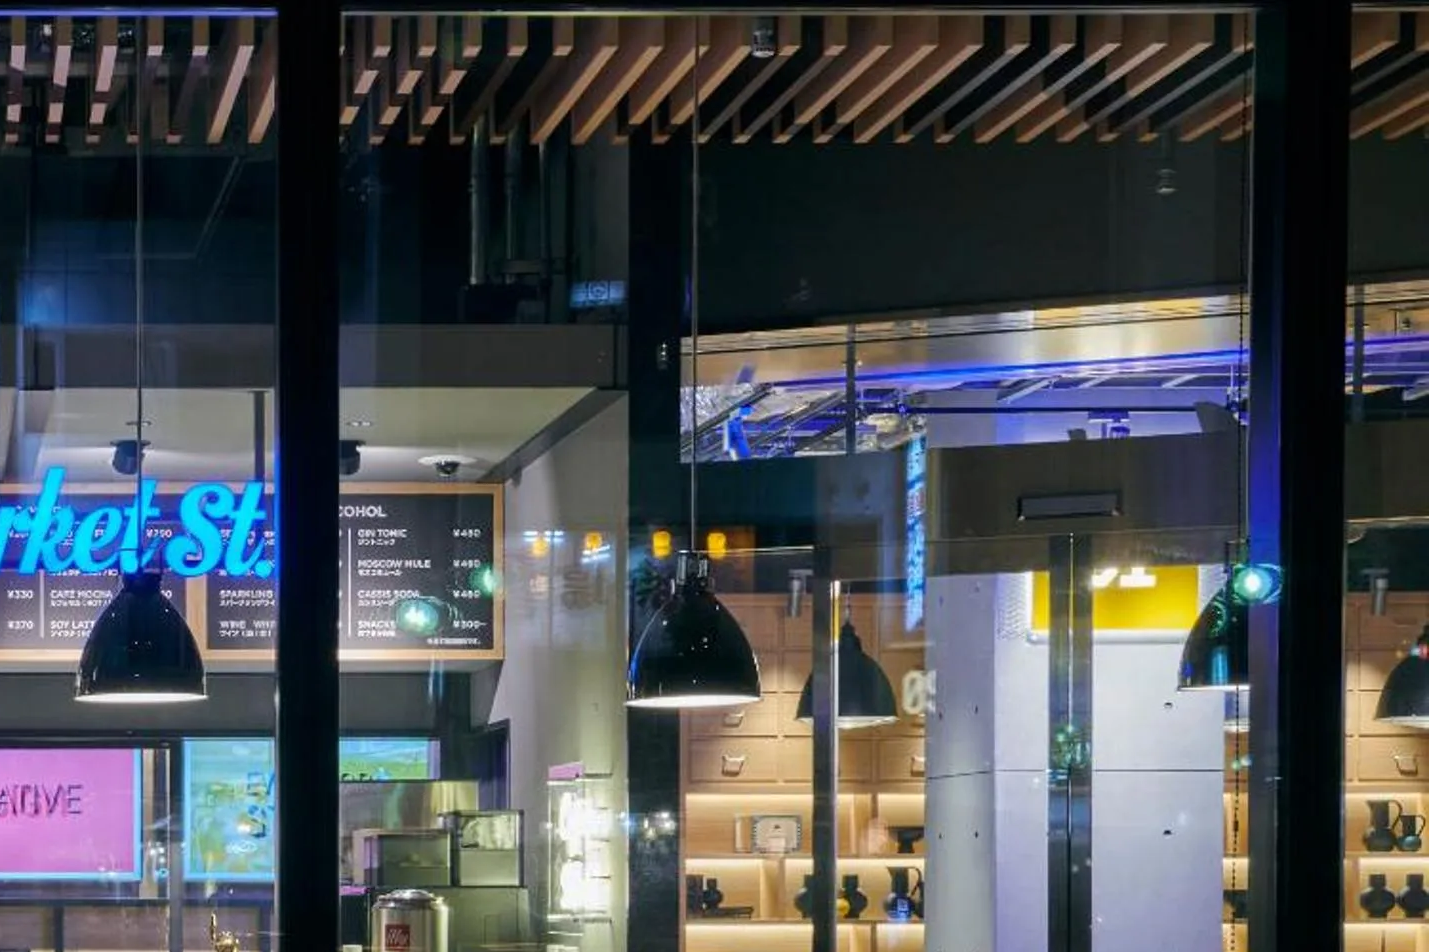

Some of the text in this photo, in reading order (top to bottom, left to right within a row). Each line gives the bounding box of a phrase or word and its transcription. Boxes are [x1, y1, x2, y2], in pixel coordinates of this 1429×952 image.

[338, 504, 387, 518] OHOL
[168, 478, 272, 579] St.
[50, 620, 95, 630] SOY LATT
